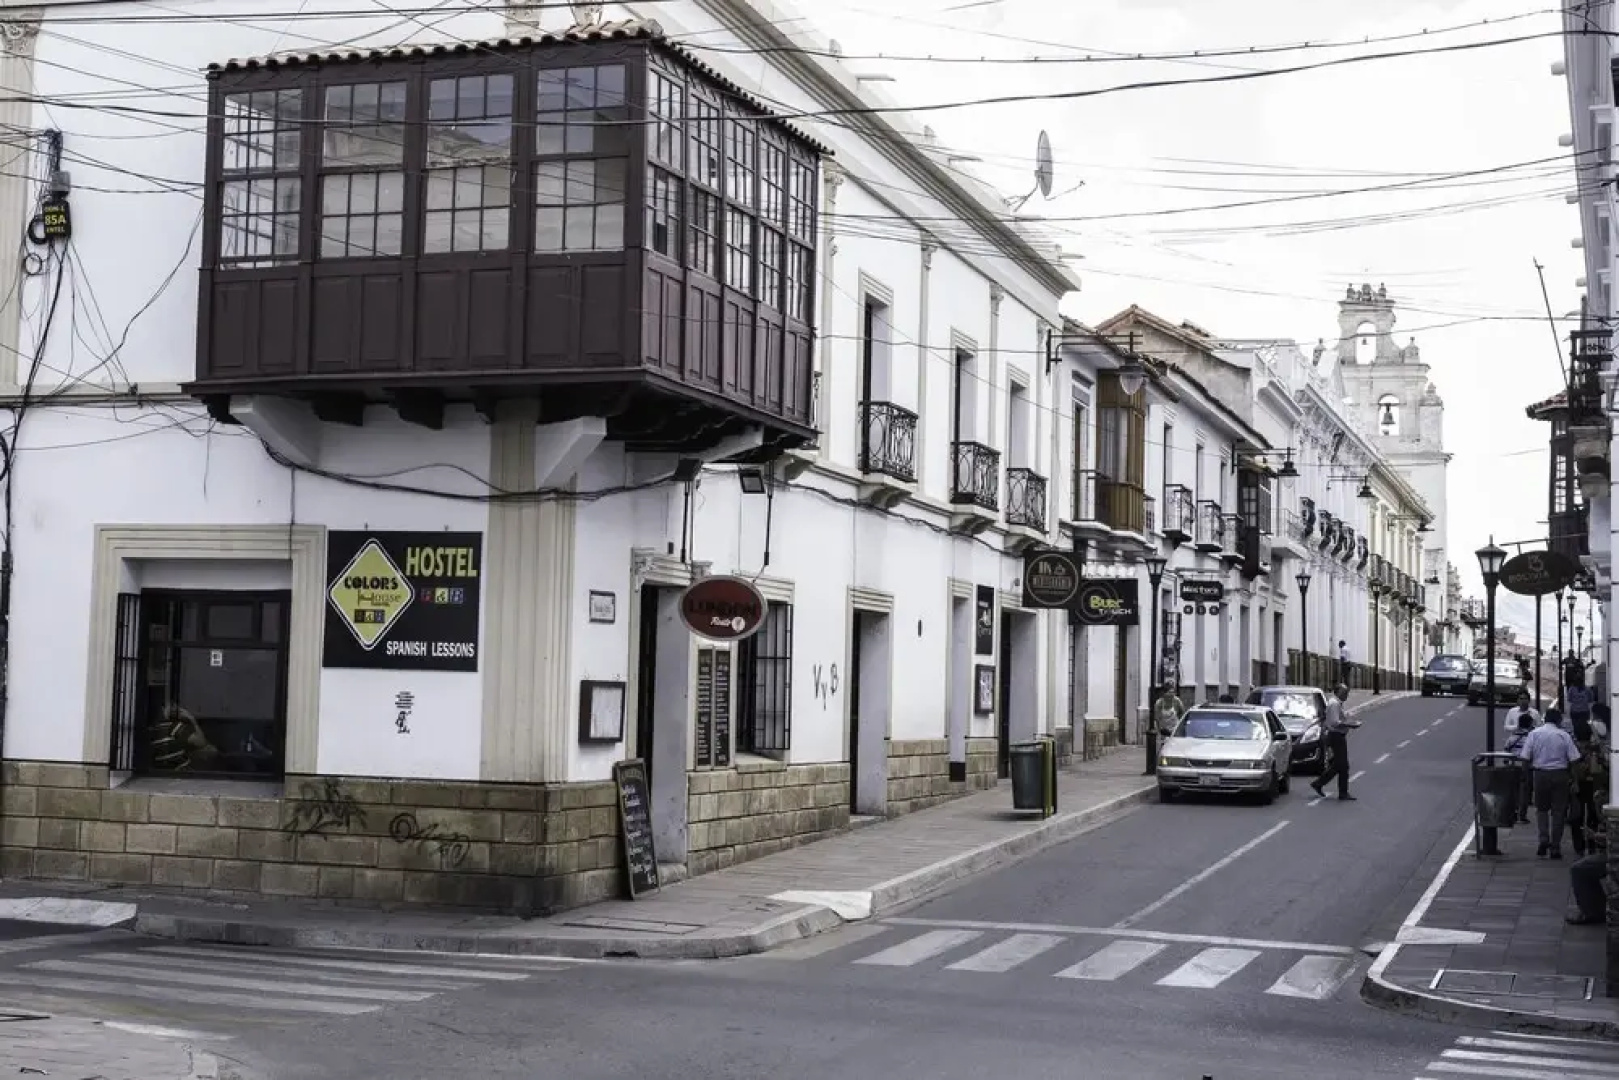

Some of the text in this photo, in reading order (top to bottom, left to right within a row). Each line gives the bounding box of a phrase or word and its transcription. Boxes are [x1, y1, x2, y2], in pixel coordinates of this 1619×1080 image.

[45, 214, 67, 226] 85A
[405, 547, 477, 577] HOSTEL
[344, 576, 399, 590] COLORS
[386, 640, 475, 657] SPANISH LESSONS
